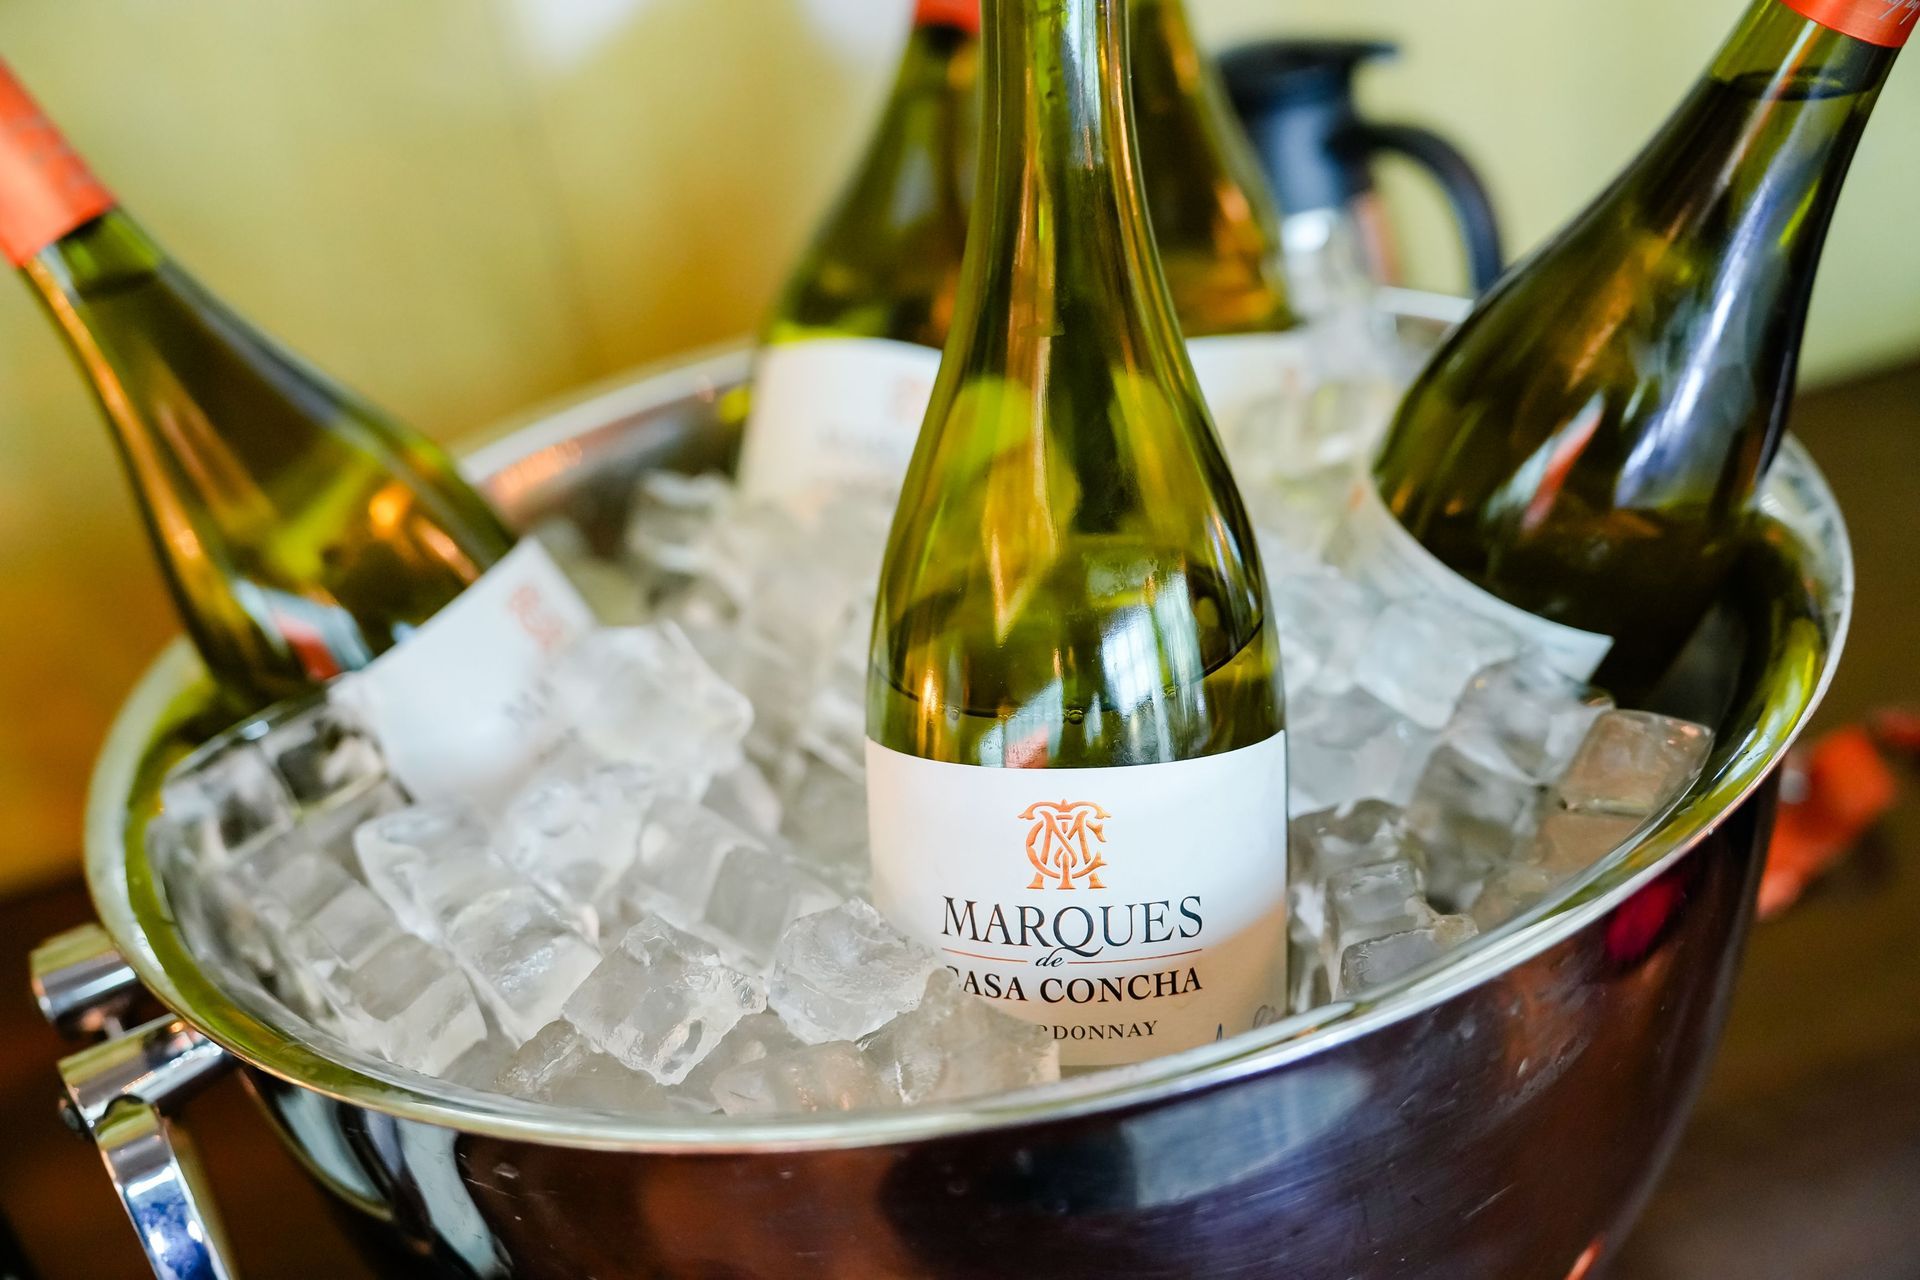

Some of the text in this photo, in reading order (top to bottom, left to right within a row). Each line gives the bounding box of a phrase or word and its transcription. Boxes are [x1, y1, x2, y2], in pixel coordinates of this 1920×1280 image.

[941, 895, 1203, 957] MARQUES
[1035, 947, 1065, 967] de
[1040, 967, 1203, 1004] CONCHA
[1037, 1020, 1158, 1041] DONNAY
